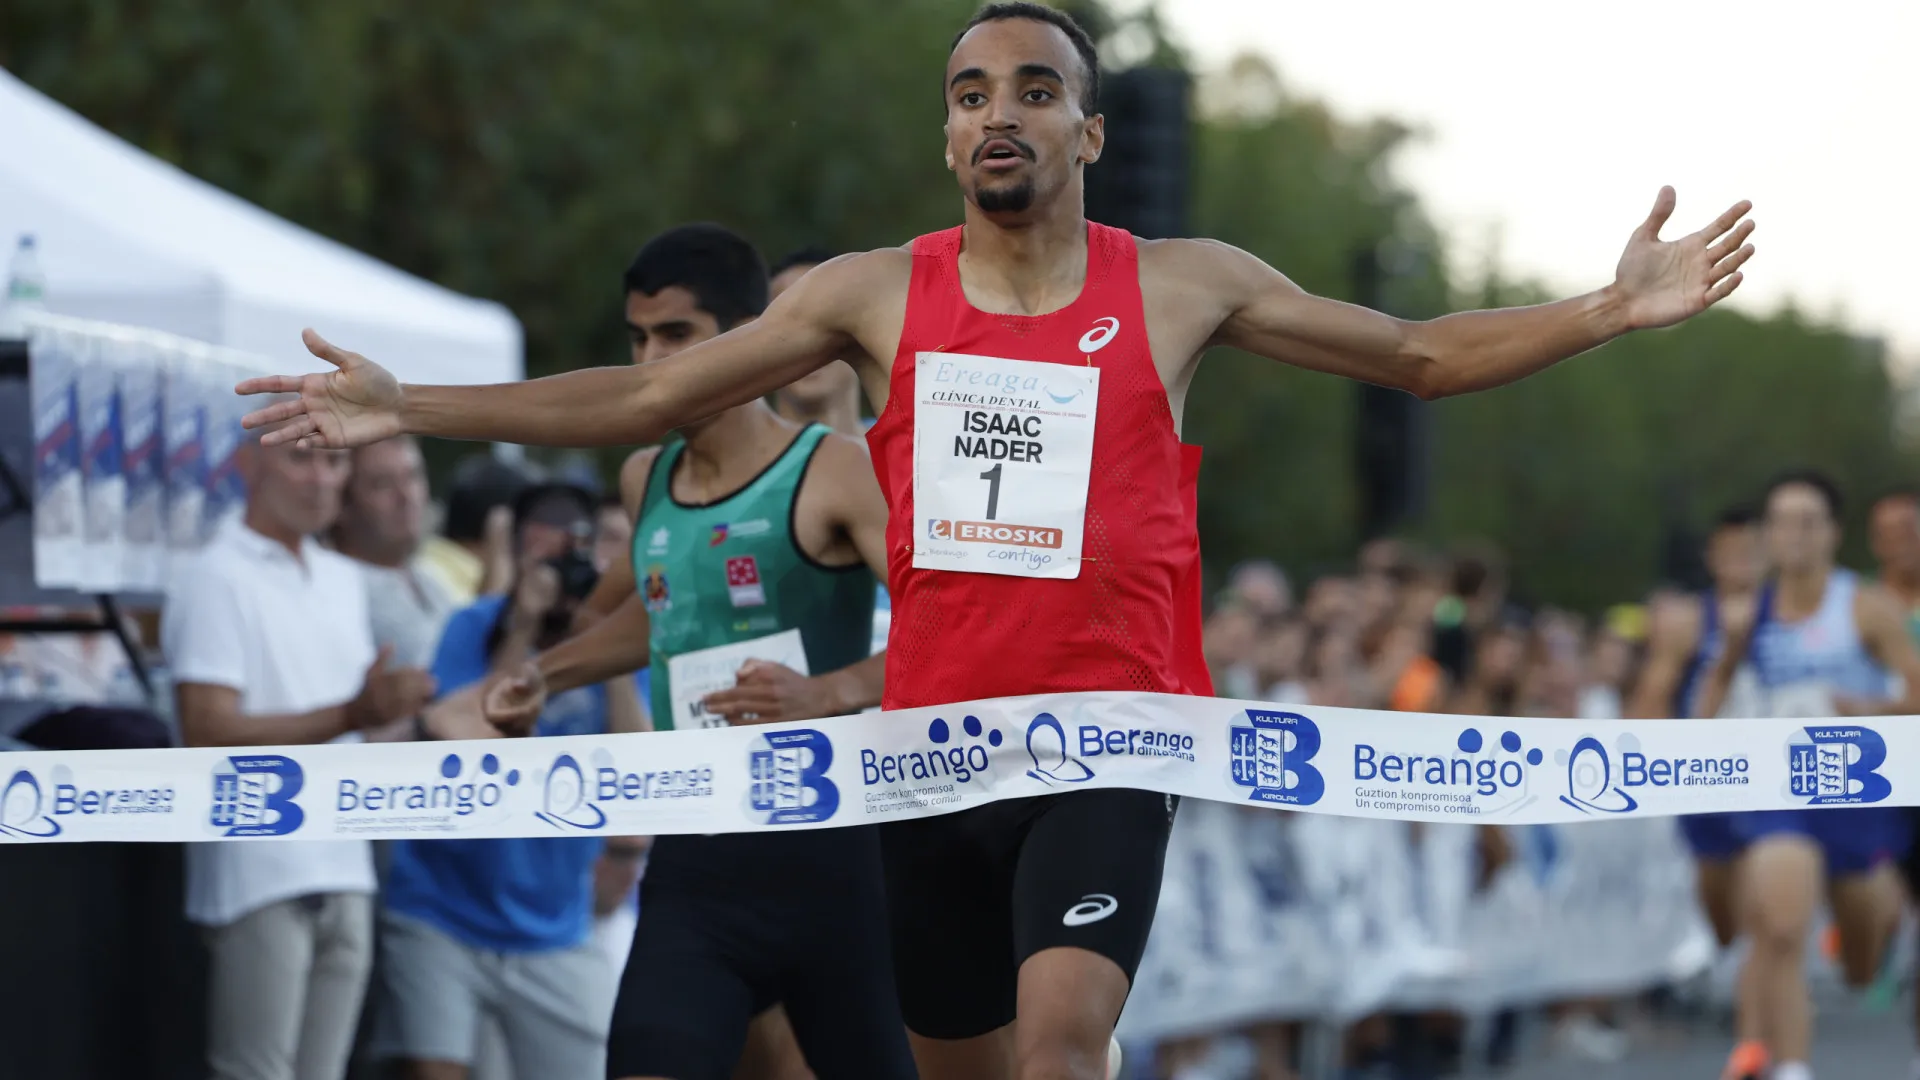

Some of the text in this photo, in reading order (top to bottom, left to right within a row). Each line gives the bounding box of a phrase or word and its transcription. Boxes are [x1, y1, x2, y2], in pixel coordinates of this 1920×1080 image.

[934, 362, 1041, 394] Ereaga
[932, 390, 985, 405] CLÍNICA
[988, 395, 1042, 409] DENTAL
[963, 410, 1042, 437] ISAAC
[954, 435, 1043, 463] NADER
[980, 463, 1003, 520] 1
[961, 524, 1055, 545] EROSKI
[987, 547, 1052, 570] contigo
[1255, 715, 1299, 726] KULTURA
[1078, 725, 1194, 757] Berango
[1814, 730, 1862, 739] KULTURA
[860, 744, 989, 785] Berango
[1353, 744, 1523, 796] Berango
[1622, 751, 1750, 787] Berango
[597, 767, 714, 801] Berango
[1682, 774, 1750, 786] dintasuna
[53, 784, 175, 815] Berango
[336, 779, 502, 816] Berango
[864, 784, 955, 803] Guztion konpromisoa
[865, 792, 962, 814] Un compromiso común
[1261, 792, 1299, 803] KIROLAK
[1355, 786, 1472, 803] Guztion konpromisoa
[1355, 798, 1481, 814] Un compromiso común
